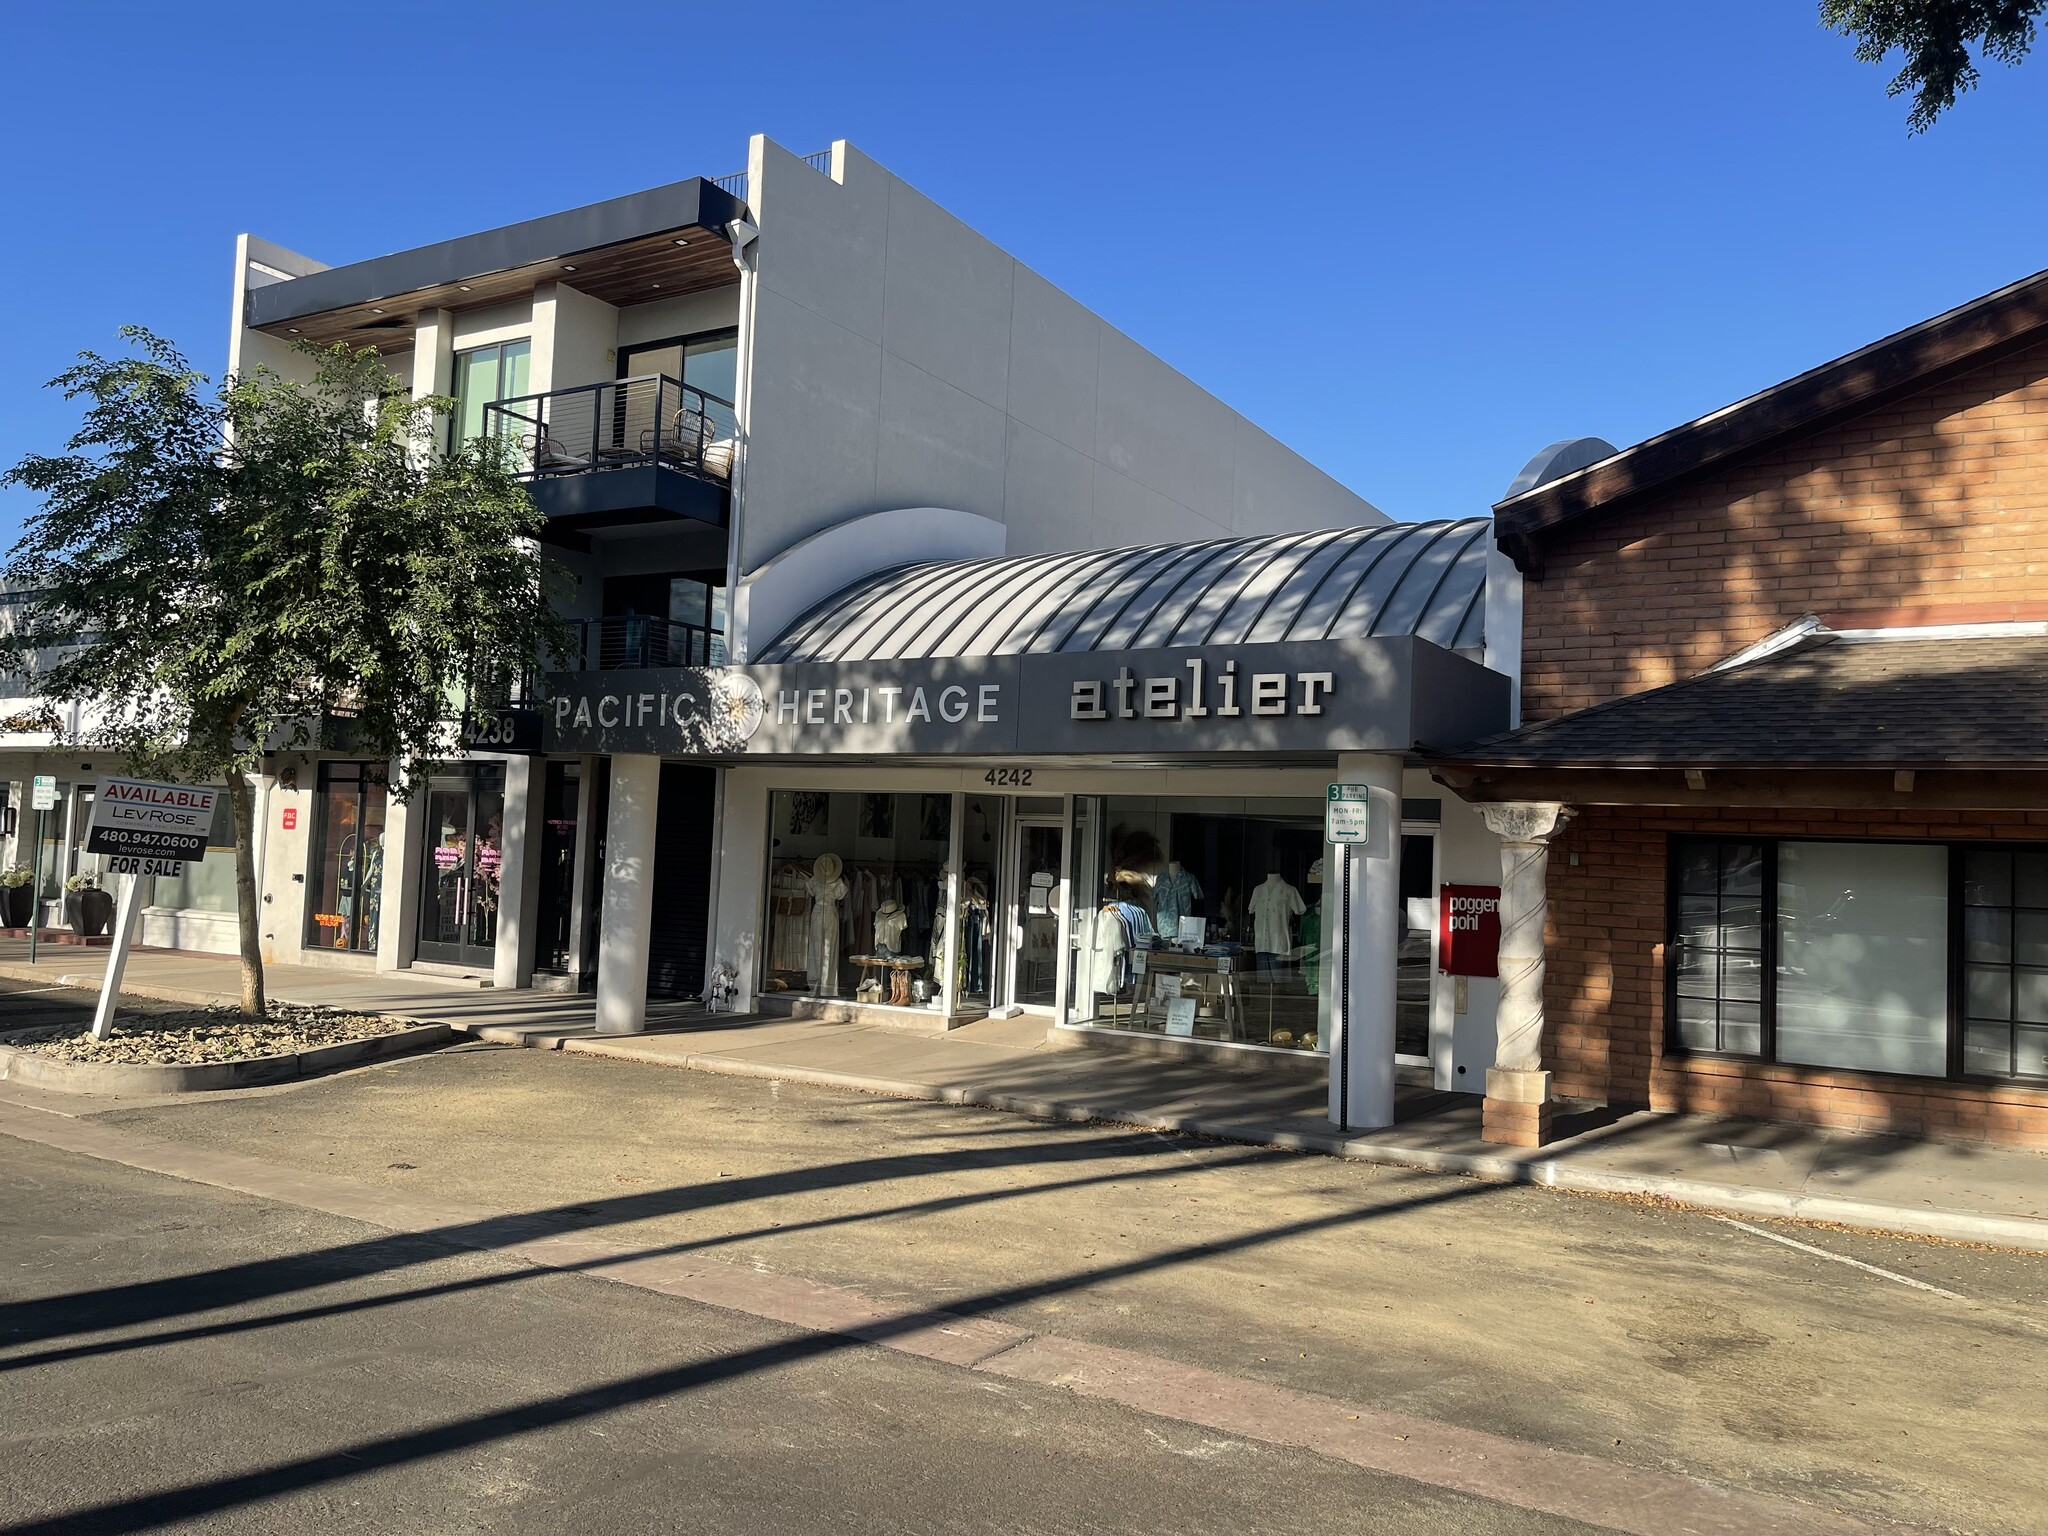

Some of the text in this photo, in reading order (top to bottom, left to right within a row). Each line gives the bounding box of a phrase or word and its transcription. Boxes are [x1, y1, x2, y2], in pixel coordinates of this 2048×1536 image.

[1071, 658, 1336, 720] atelier
[555, 684, 1000, 728] PACIFIC HERITAGE
[463, 717, 515, 744] 4238
[36, 777, 41, 786] 3
[984, 768, 1033, 786] 4242
[104, 784, 213, 809] AVAILABLE
[1331, 785, 1339, 800] 3
[99, 830, 199, 849] 480.947.0600
[118, 844, 176, 857] levrose.com
[108, 856, 182, 877] FOR SALE
[1449, 897, 1500, 914] poggen
[1448, 914, 1479, 933] pohl
